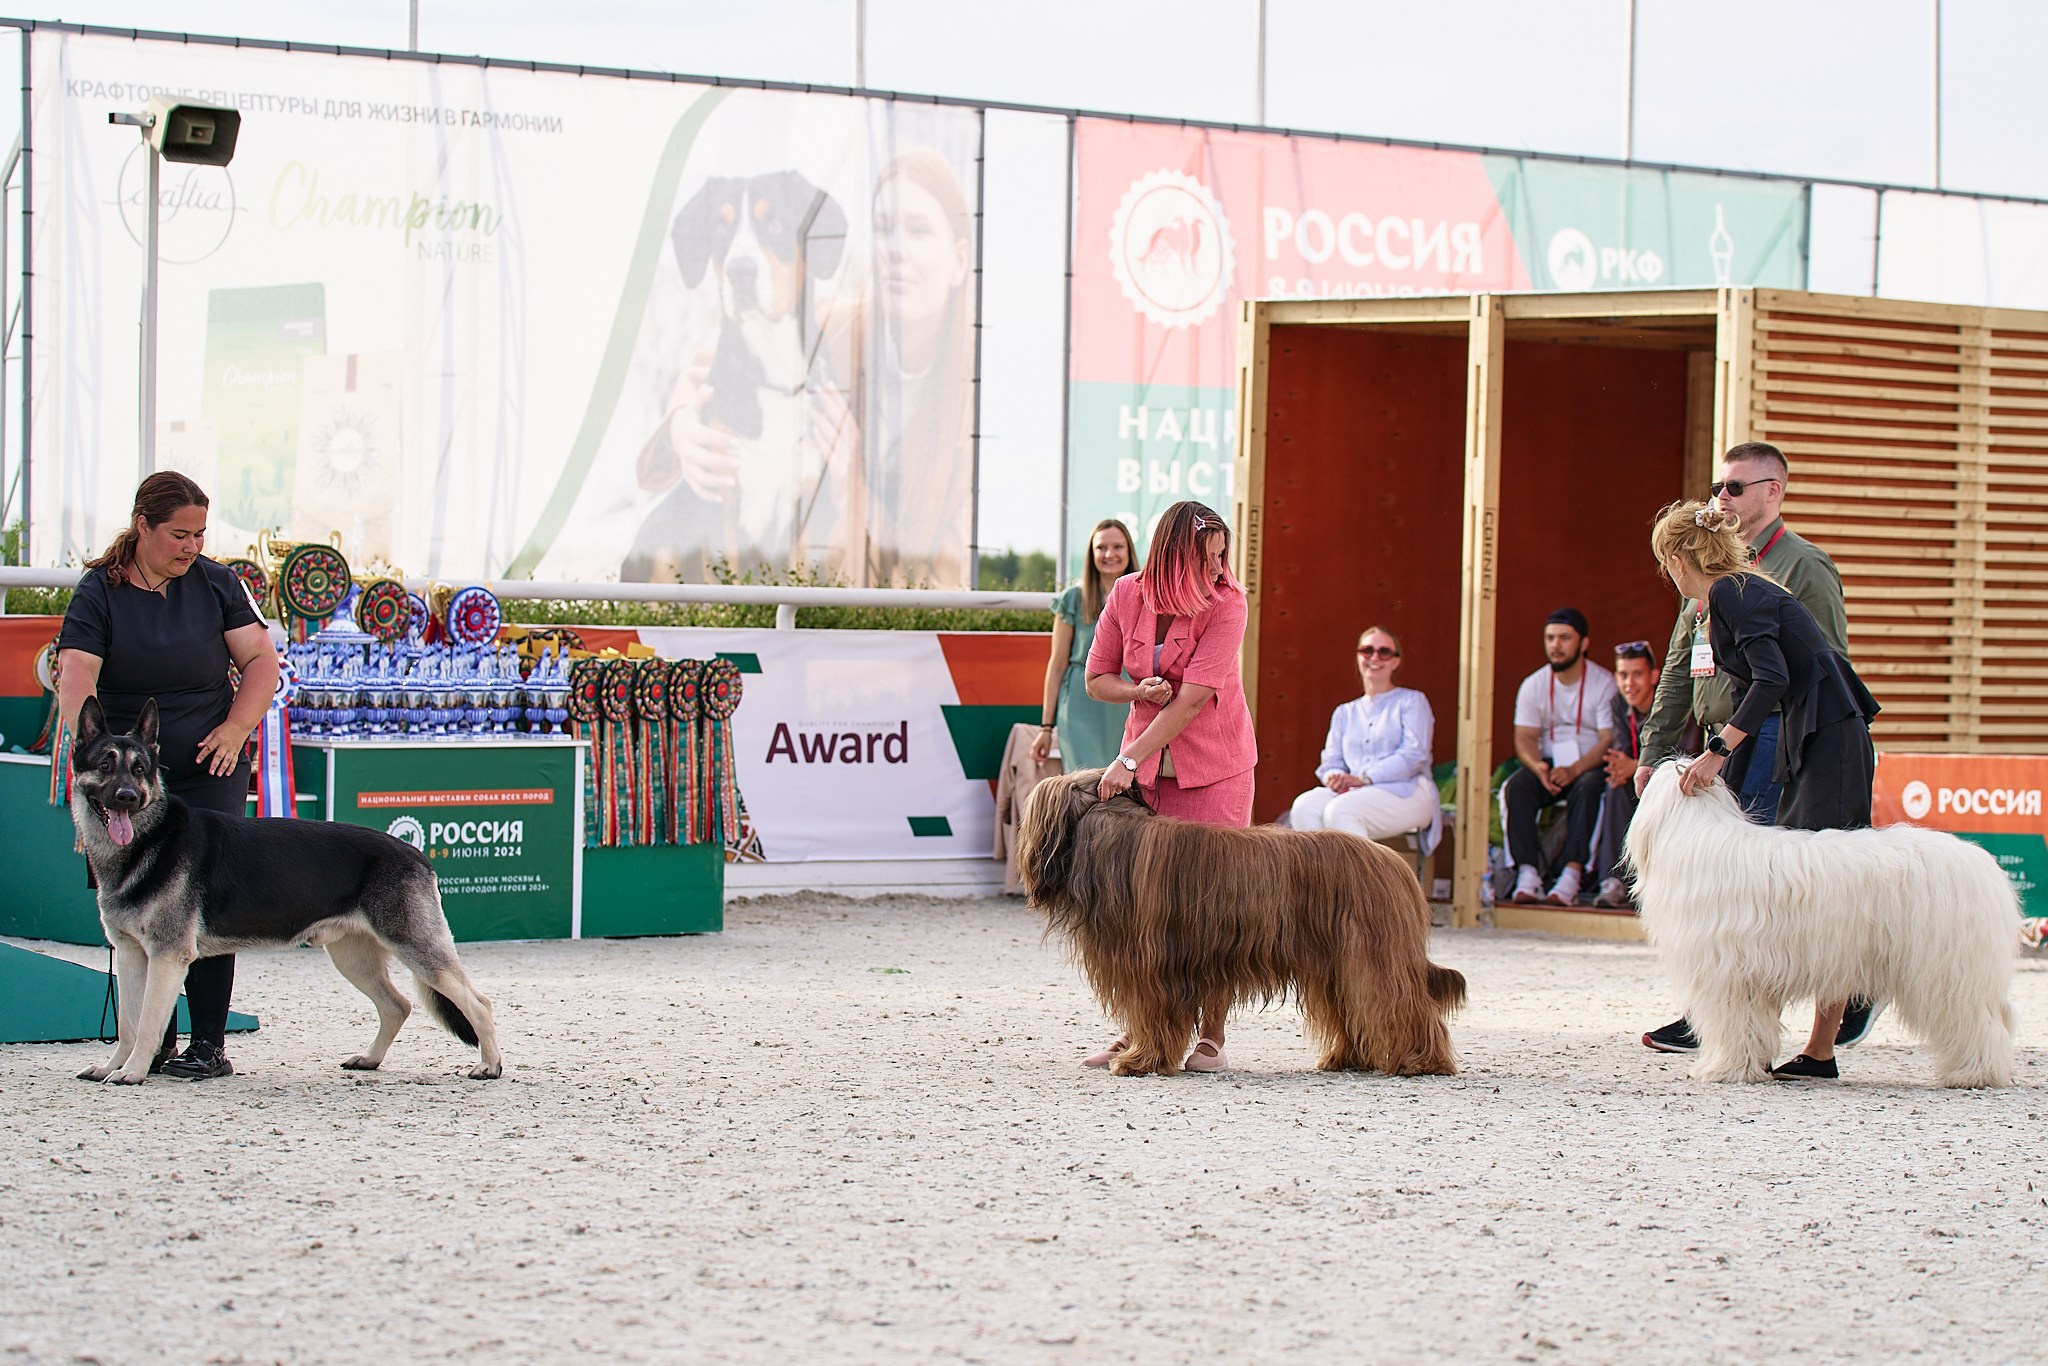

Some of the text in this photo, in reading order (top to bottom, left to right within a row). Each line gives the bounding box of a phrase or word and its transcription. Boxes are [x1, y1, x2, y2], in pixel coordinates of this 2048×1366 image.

[198, 90, 319, 116] РЕЦЕПТУРЫ
[324, 99, 362, 120] ДЛЯ
[367, 101, 440, 125] ЖИЗНИ
[444, 108, 457, 126] В
[460, 109, 563, 134] ГАРМОНИИ
[267, 158, 504, 248] Champion
[416, 240, 494, 264] NATURE
[1263, 206, 1484, 274] РОССИЯ
[1601, 245, 1665, 283] РКФ
[765, 721, 908, 763] Award
[361, 792, 550, 804] НАЦИОНАЛЬНЫЕ ВЫСТАВКИ СОБАК ВСЕХ ПОРОД
[1938, 788, 2042, 815] РОССИЯ
[430, 820, 523, 845] РОССИЯ
[429, 846, 522, 859] 8-9 ИЮНЯ 2024
